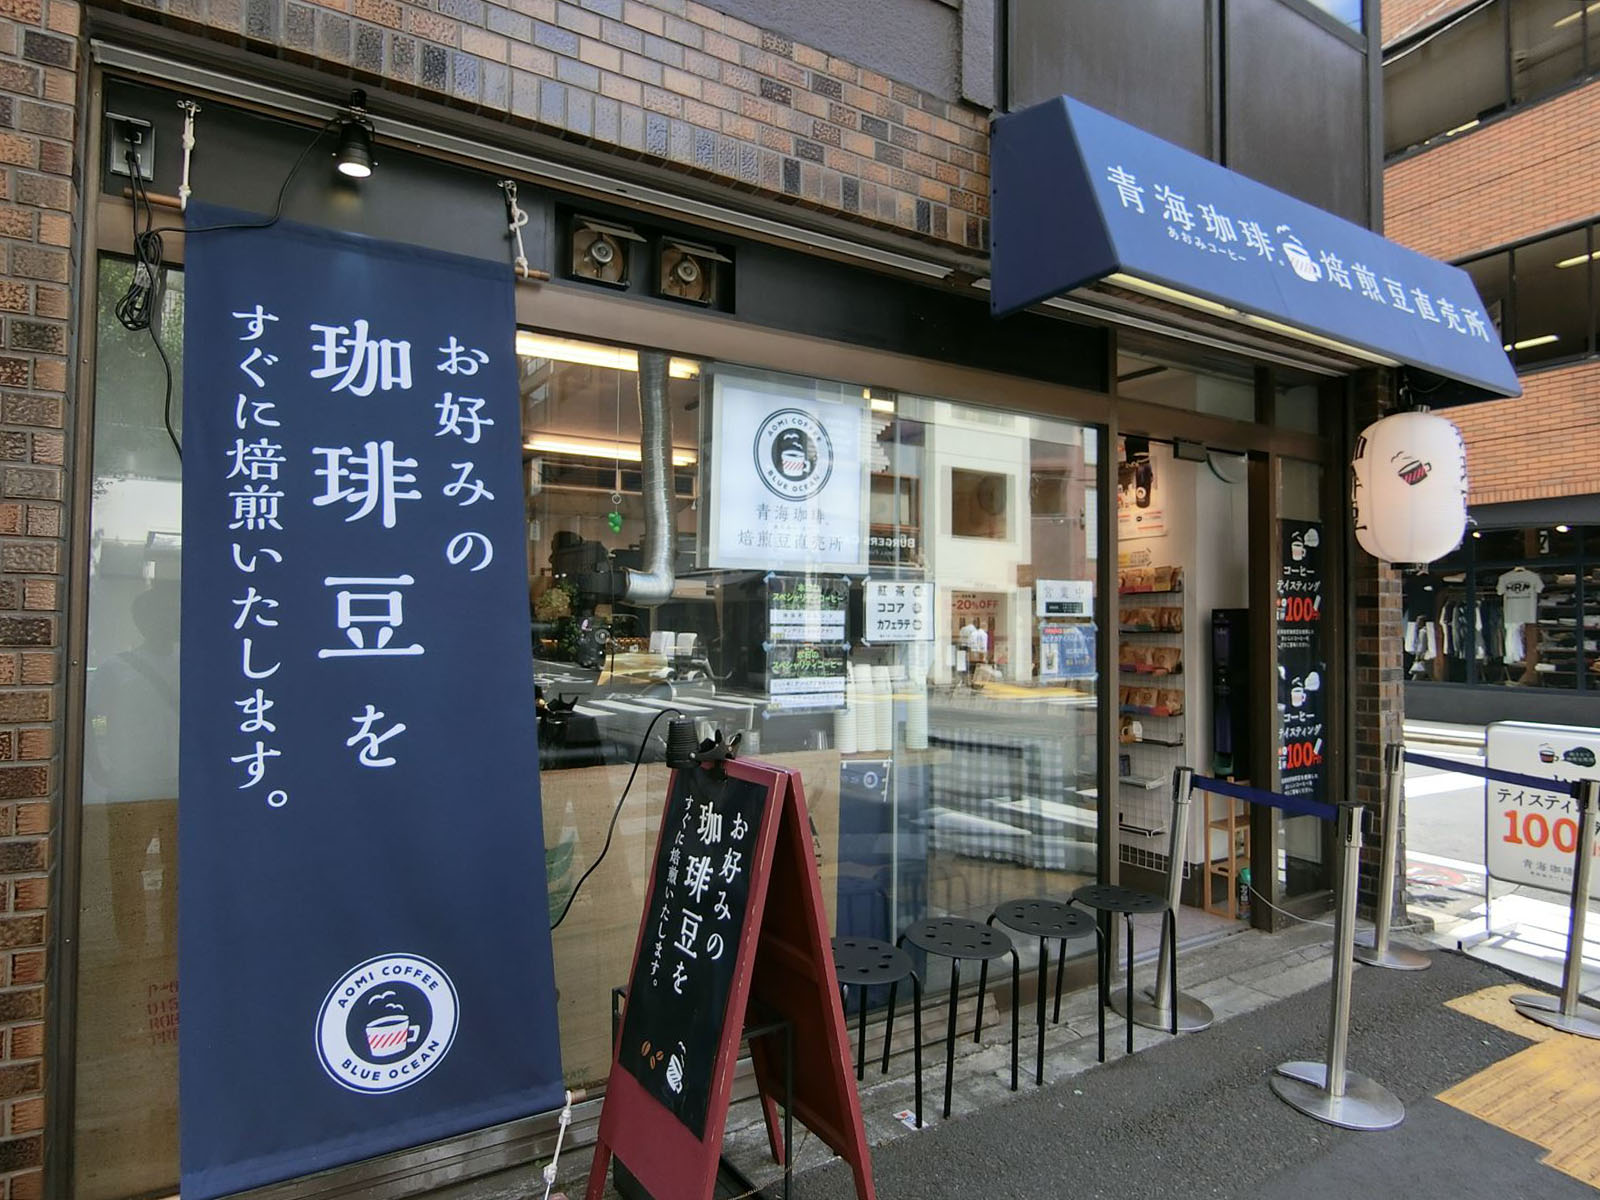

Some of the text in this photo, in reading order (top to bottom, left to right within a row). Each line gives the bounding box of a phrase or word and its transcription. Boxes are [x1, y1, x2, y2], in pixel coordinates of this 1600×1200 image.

[1319, 250, 1490, 343] 焙煎豆直売所
[434, 336, 495, 572] お好みの
[226, 304, 288, 808] すぐに焙煎いたします。
[310, 319, 425, 767] 珈琲豆を
[1277, 579, 1321, 592] テイスティング
[1283, 565, 1315, 577] コーヒー
[877, 603, 905, 613] ココア
[877, 620, 911, 631] カフェラテ
[1279, 723, 1322, 739] テイスティング
[1283, 711, 1315, 722] コーヒー
[1503, 810, 1578, 853] 100
[672, 801, 724, 995] 珈琲豆を
[706, 812, 749, 960] お好みの
[338, 965, 439, 1009] AOMI COFFEE
[341, 1040, 440, 1081] BLUE OCEAN
